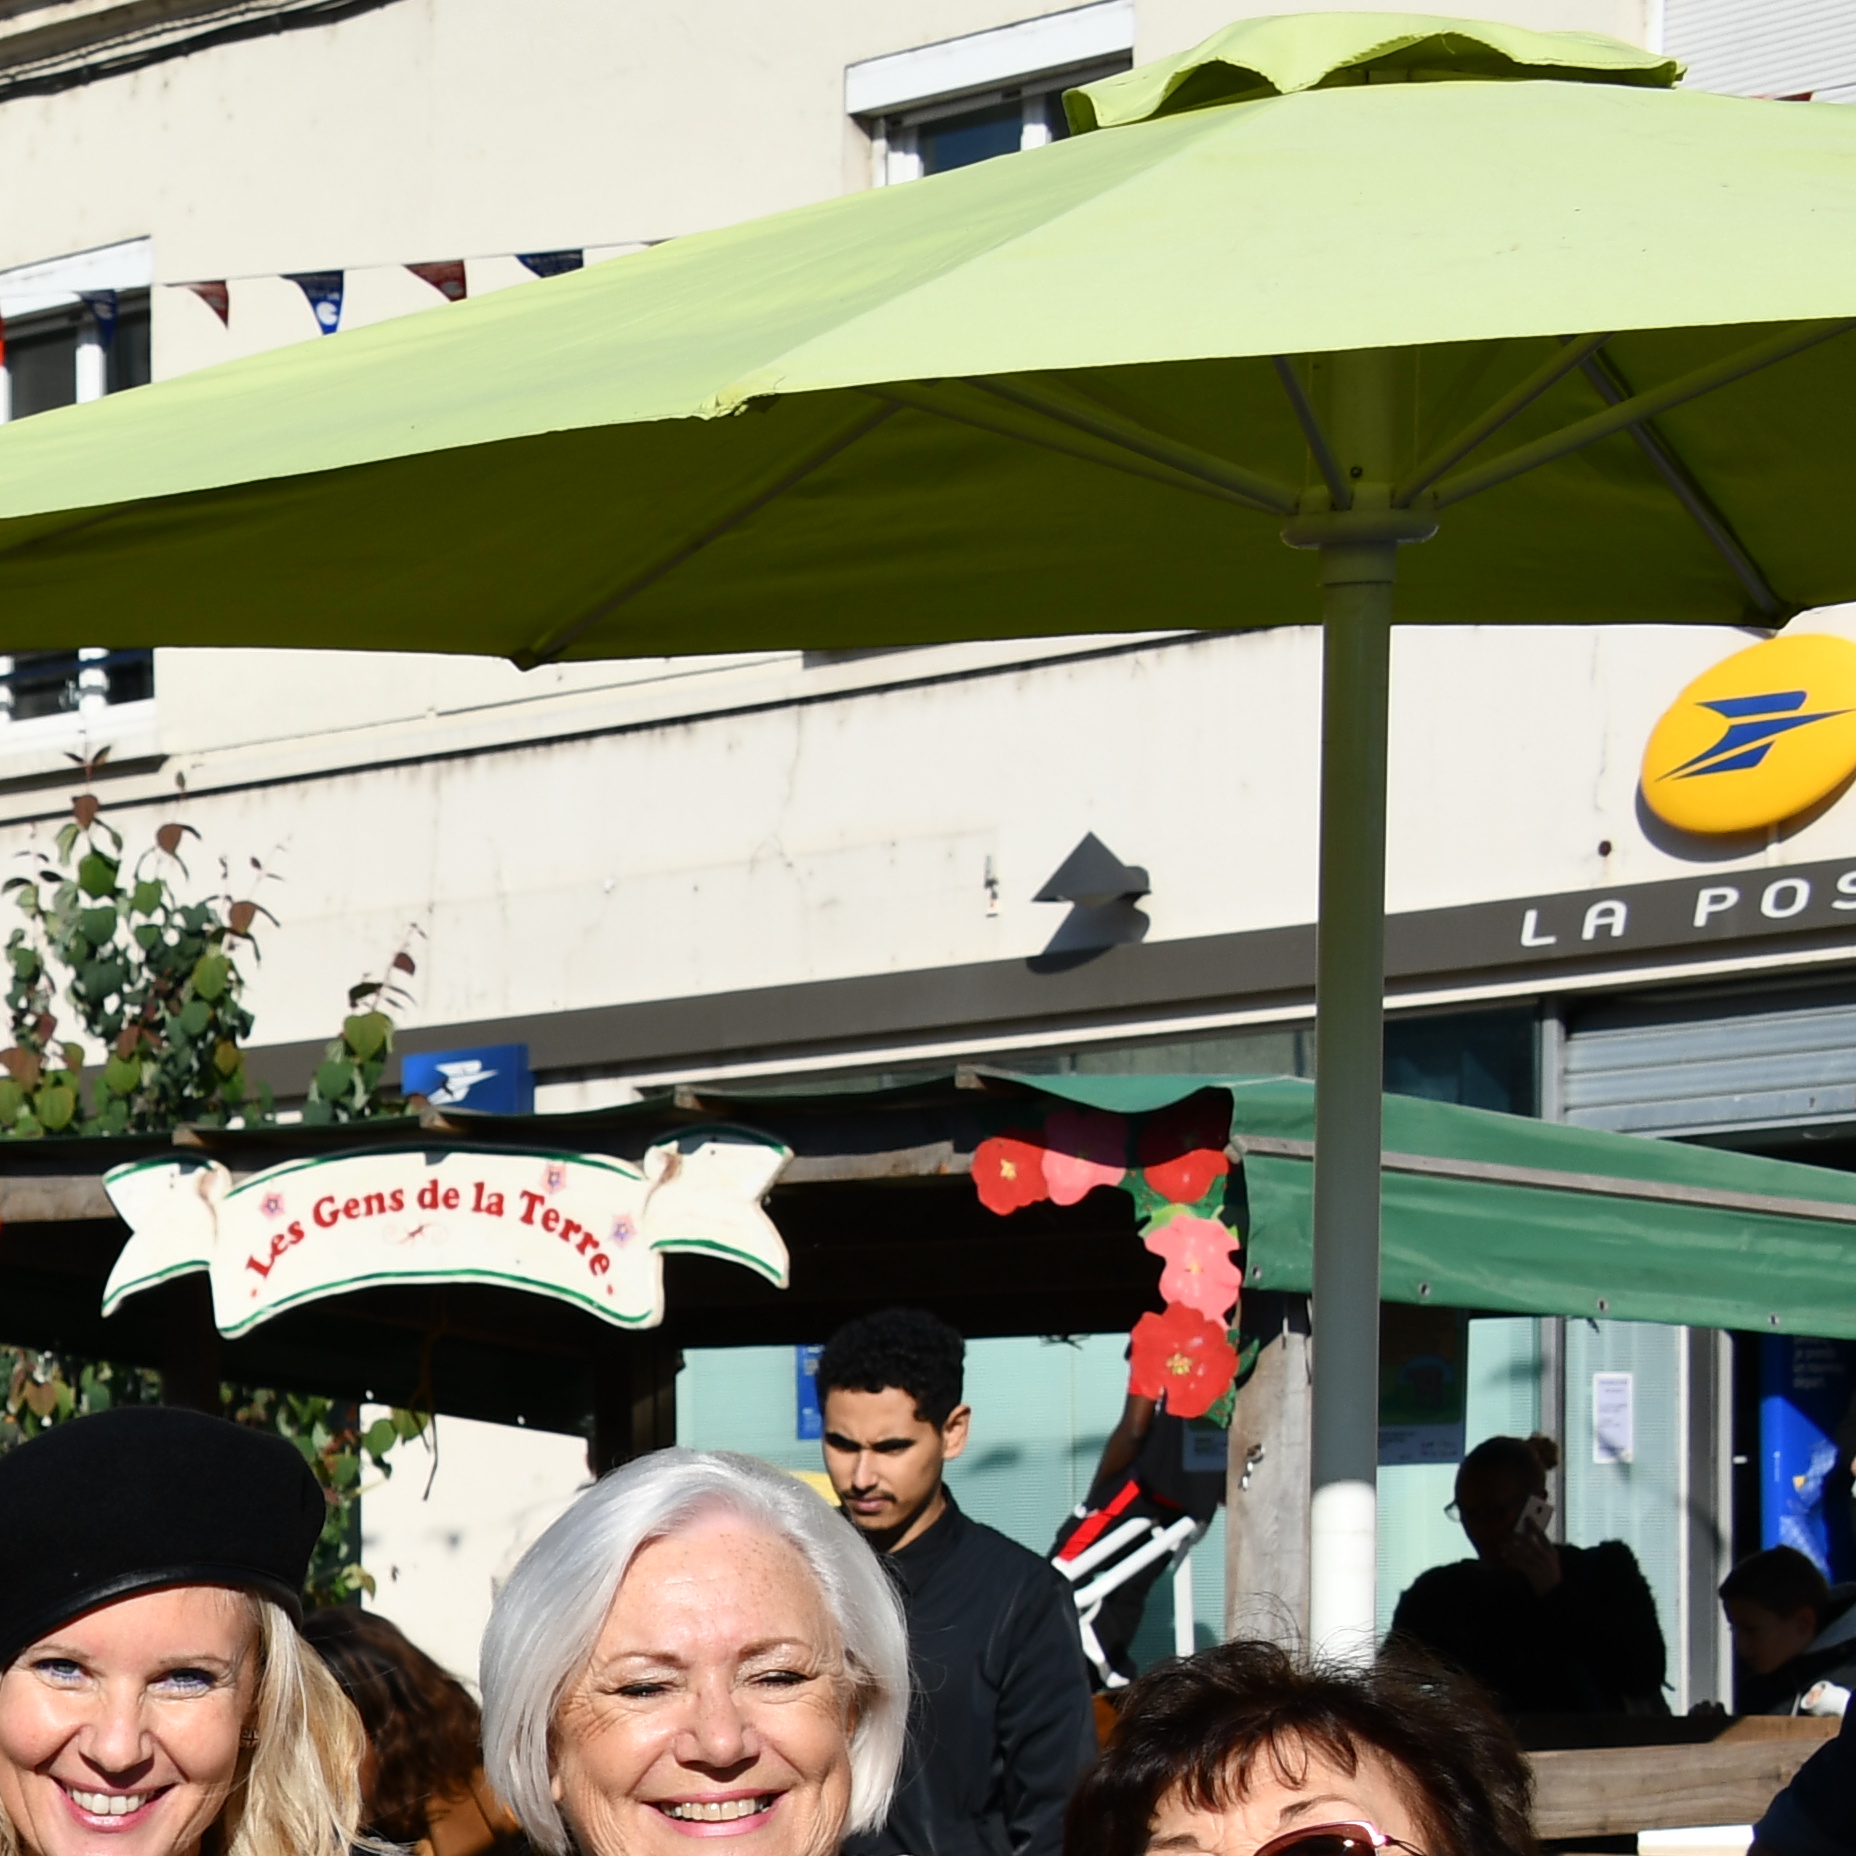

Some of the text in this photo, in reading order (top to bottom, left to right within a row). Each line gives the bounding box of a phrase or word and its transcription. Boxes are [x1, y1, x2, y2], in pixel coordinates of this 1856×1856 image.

[1520, 899, 1630, 948] LA
[246, 1178, 611, 1279] Les Gens de la Terre
